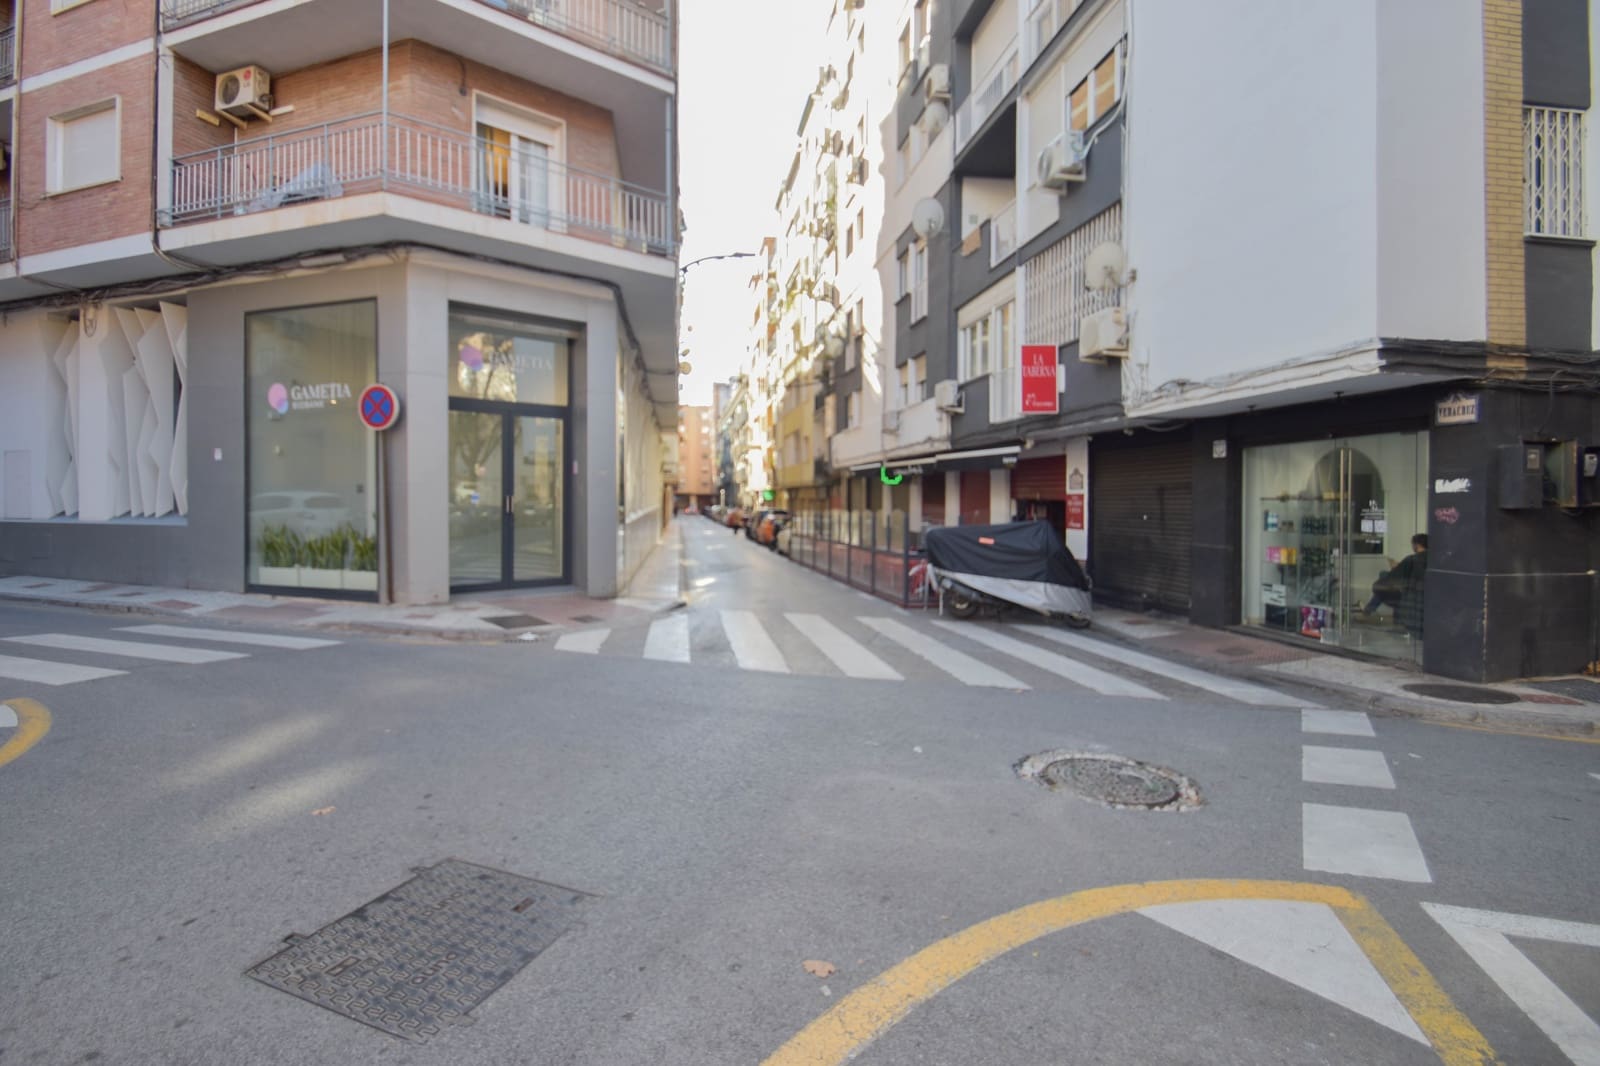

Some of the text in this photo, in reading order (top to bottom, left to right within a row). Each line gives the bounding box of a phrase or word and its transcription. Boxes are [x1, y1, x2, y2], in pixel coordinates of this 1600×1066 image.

[1032, 353, 1044, 367] LA
[1023, 366, 1056, 377] TABERNA
[291, 383, 351, 400] GAMETIA
[1439, 405, 1475, 417] VERACRUZ
